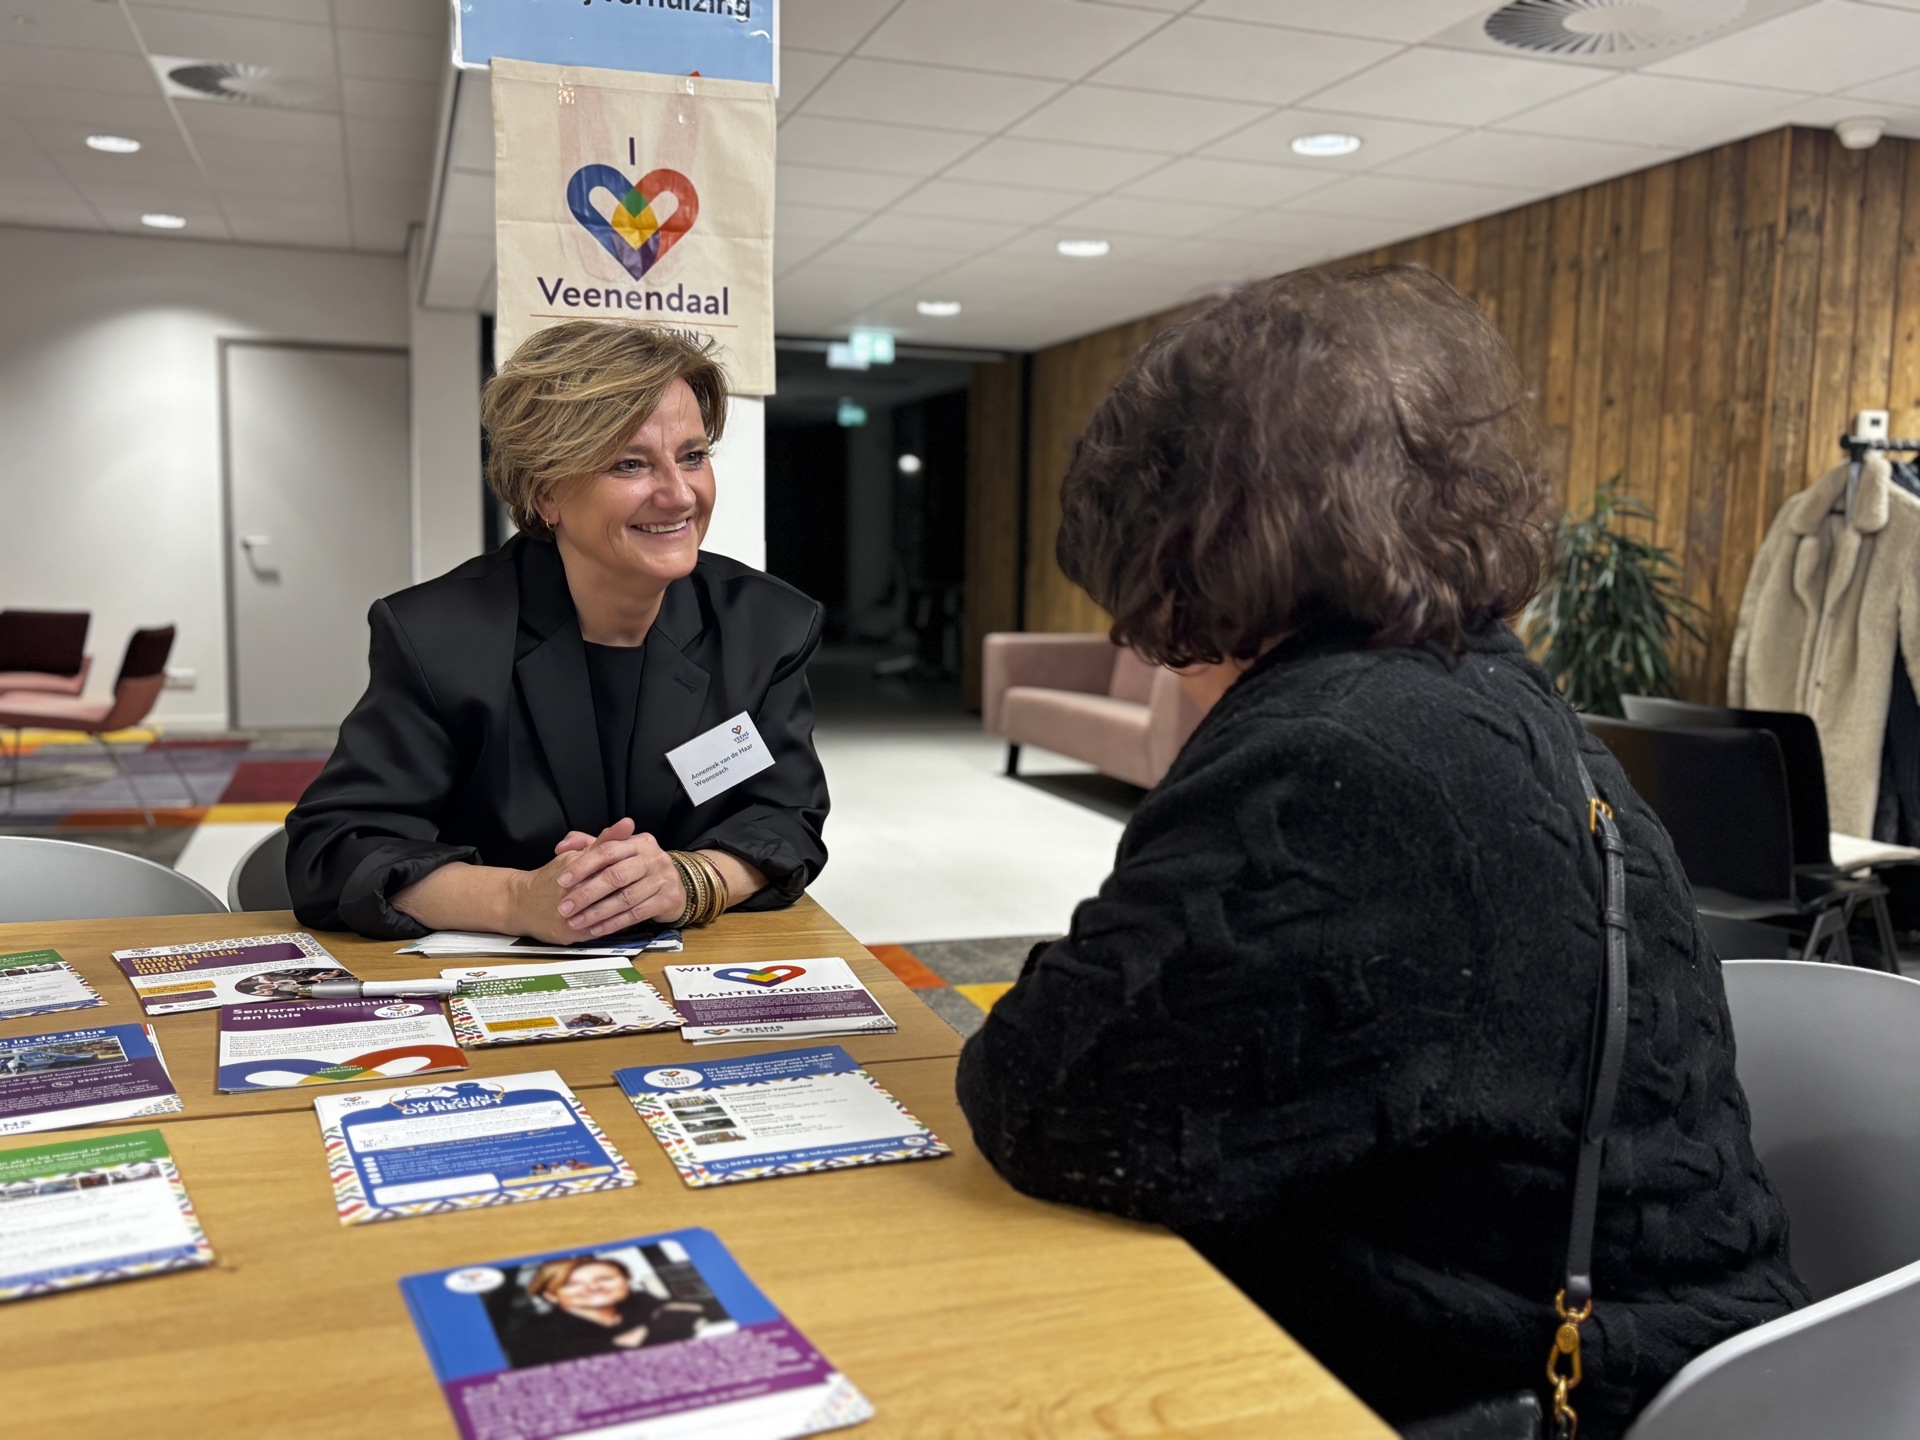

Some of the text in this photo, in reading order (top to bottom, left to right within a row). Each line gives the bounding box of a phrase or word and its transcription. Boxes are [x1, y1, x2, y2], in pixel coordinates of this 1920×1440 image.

[628, 137, 636, 166] I
[536, 276, 729, 316] Veenendaal
[690, 744, 753, 780] Annemiek van de Haar
[694, 766, 729, 787] Wooncoach
[131, 953, 188, 965] SAMEN
[191, 949, 244, 960] DELEN,
[134, 958, 199, 971] DURVEN
[137, 965, 187, 975] DOEN!
[688, 983, 855, 999] MANTELZORGERS
[232, 998, 404, 1015] Seniorenvoorlichting
[45, 1034, 99, 1043] Veenendaal
[402, 1098, 503, 1115] OP RECEPT
[410, 1095, 490, 1108] WELZIJN
